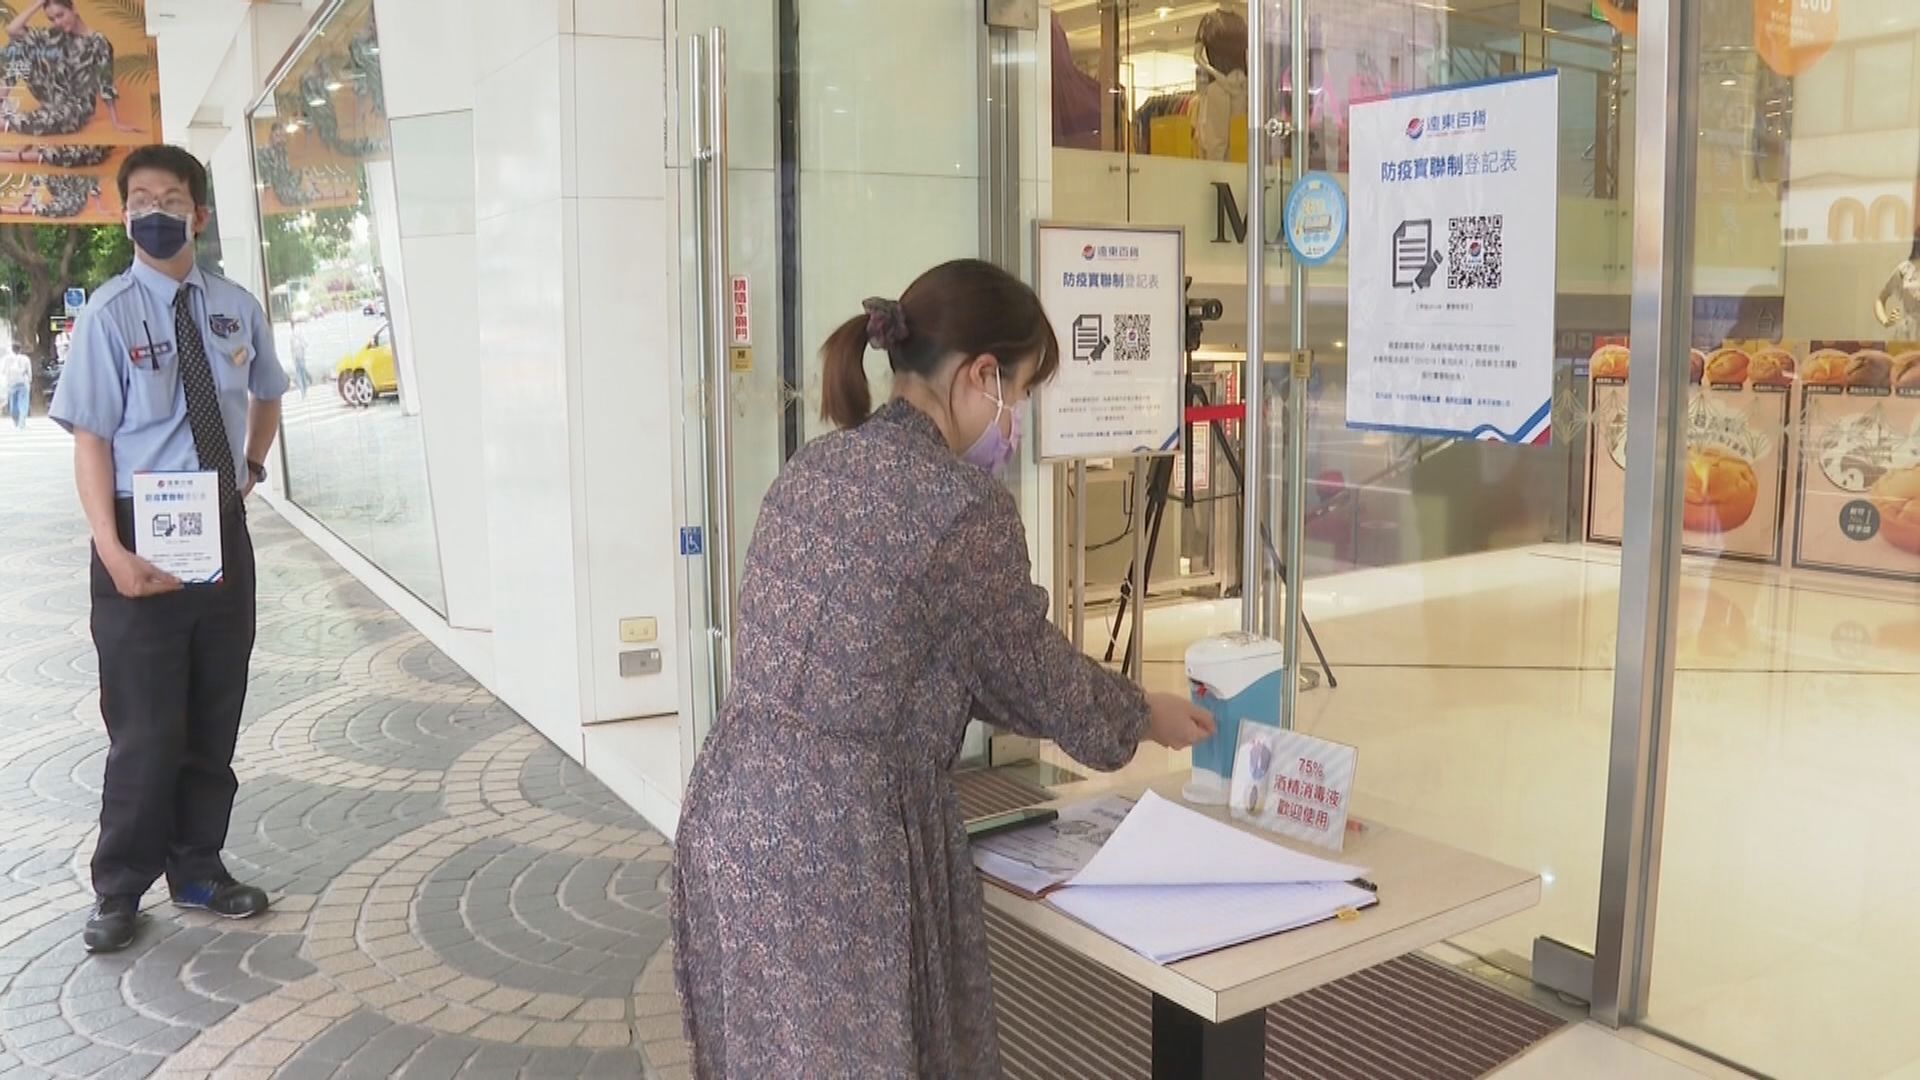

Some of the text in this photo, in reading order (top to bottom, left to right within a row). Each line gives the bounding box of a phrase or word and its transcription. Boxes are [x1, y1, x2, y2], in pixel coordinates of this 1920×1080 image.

[1380, 149, 1517, 182] 防疫實聯制登記表
[1062, 272, 1159, 289] 防疫實聯制登記表
[1298, 758, 1325, 777] 75%
[1274, 774, 1340, 808] 酒精消毒液
[1277, 798, 1329, 829] 歡迎使用
